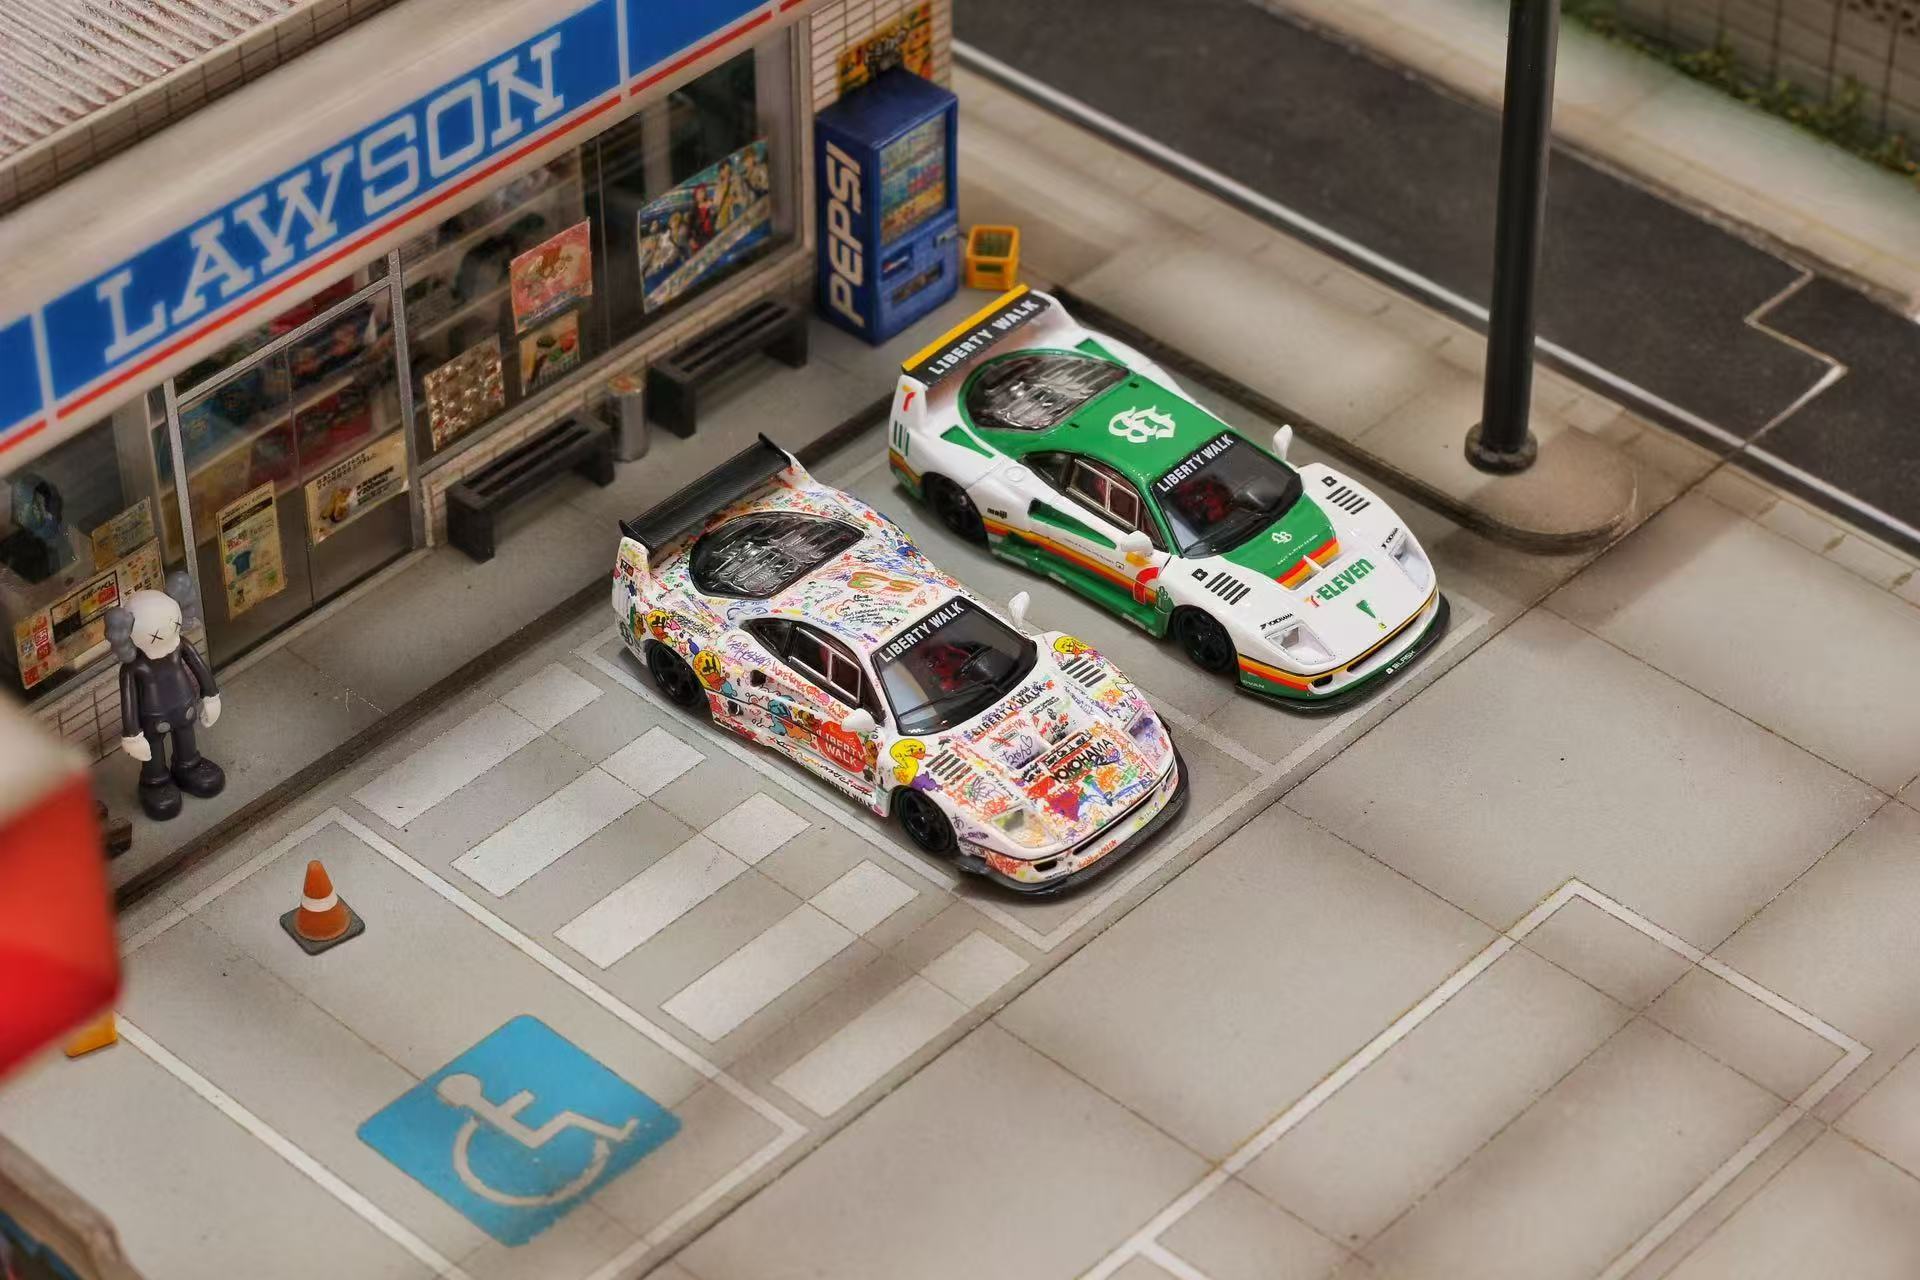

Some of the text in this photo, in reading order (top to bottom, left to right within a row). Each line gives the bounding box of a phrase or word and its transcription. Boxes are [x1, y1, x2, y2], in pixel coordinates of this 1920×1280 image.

[97, 31, 565, 364] LAWSON
[826, 140, 865, 328] PEPSI
[928, 300, 1039, 375] LIBERTY WALK
[1157, 434, 1234, 492] LIBERTY WALK
[879, 622, 931, 663] LIBERTY
[928, 602, 964, 629] WALK
[971, 704, 1015, 737] LIBERTY
[1016, 683, 1046, 708] WALK
[825, 742, 858, 769] WALK
[1049, 738, 1113, 784] YOKOHAMA
